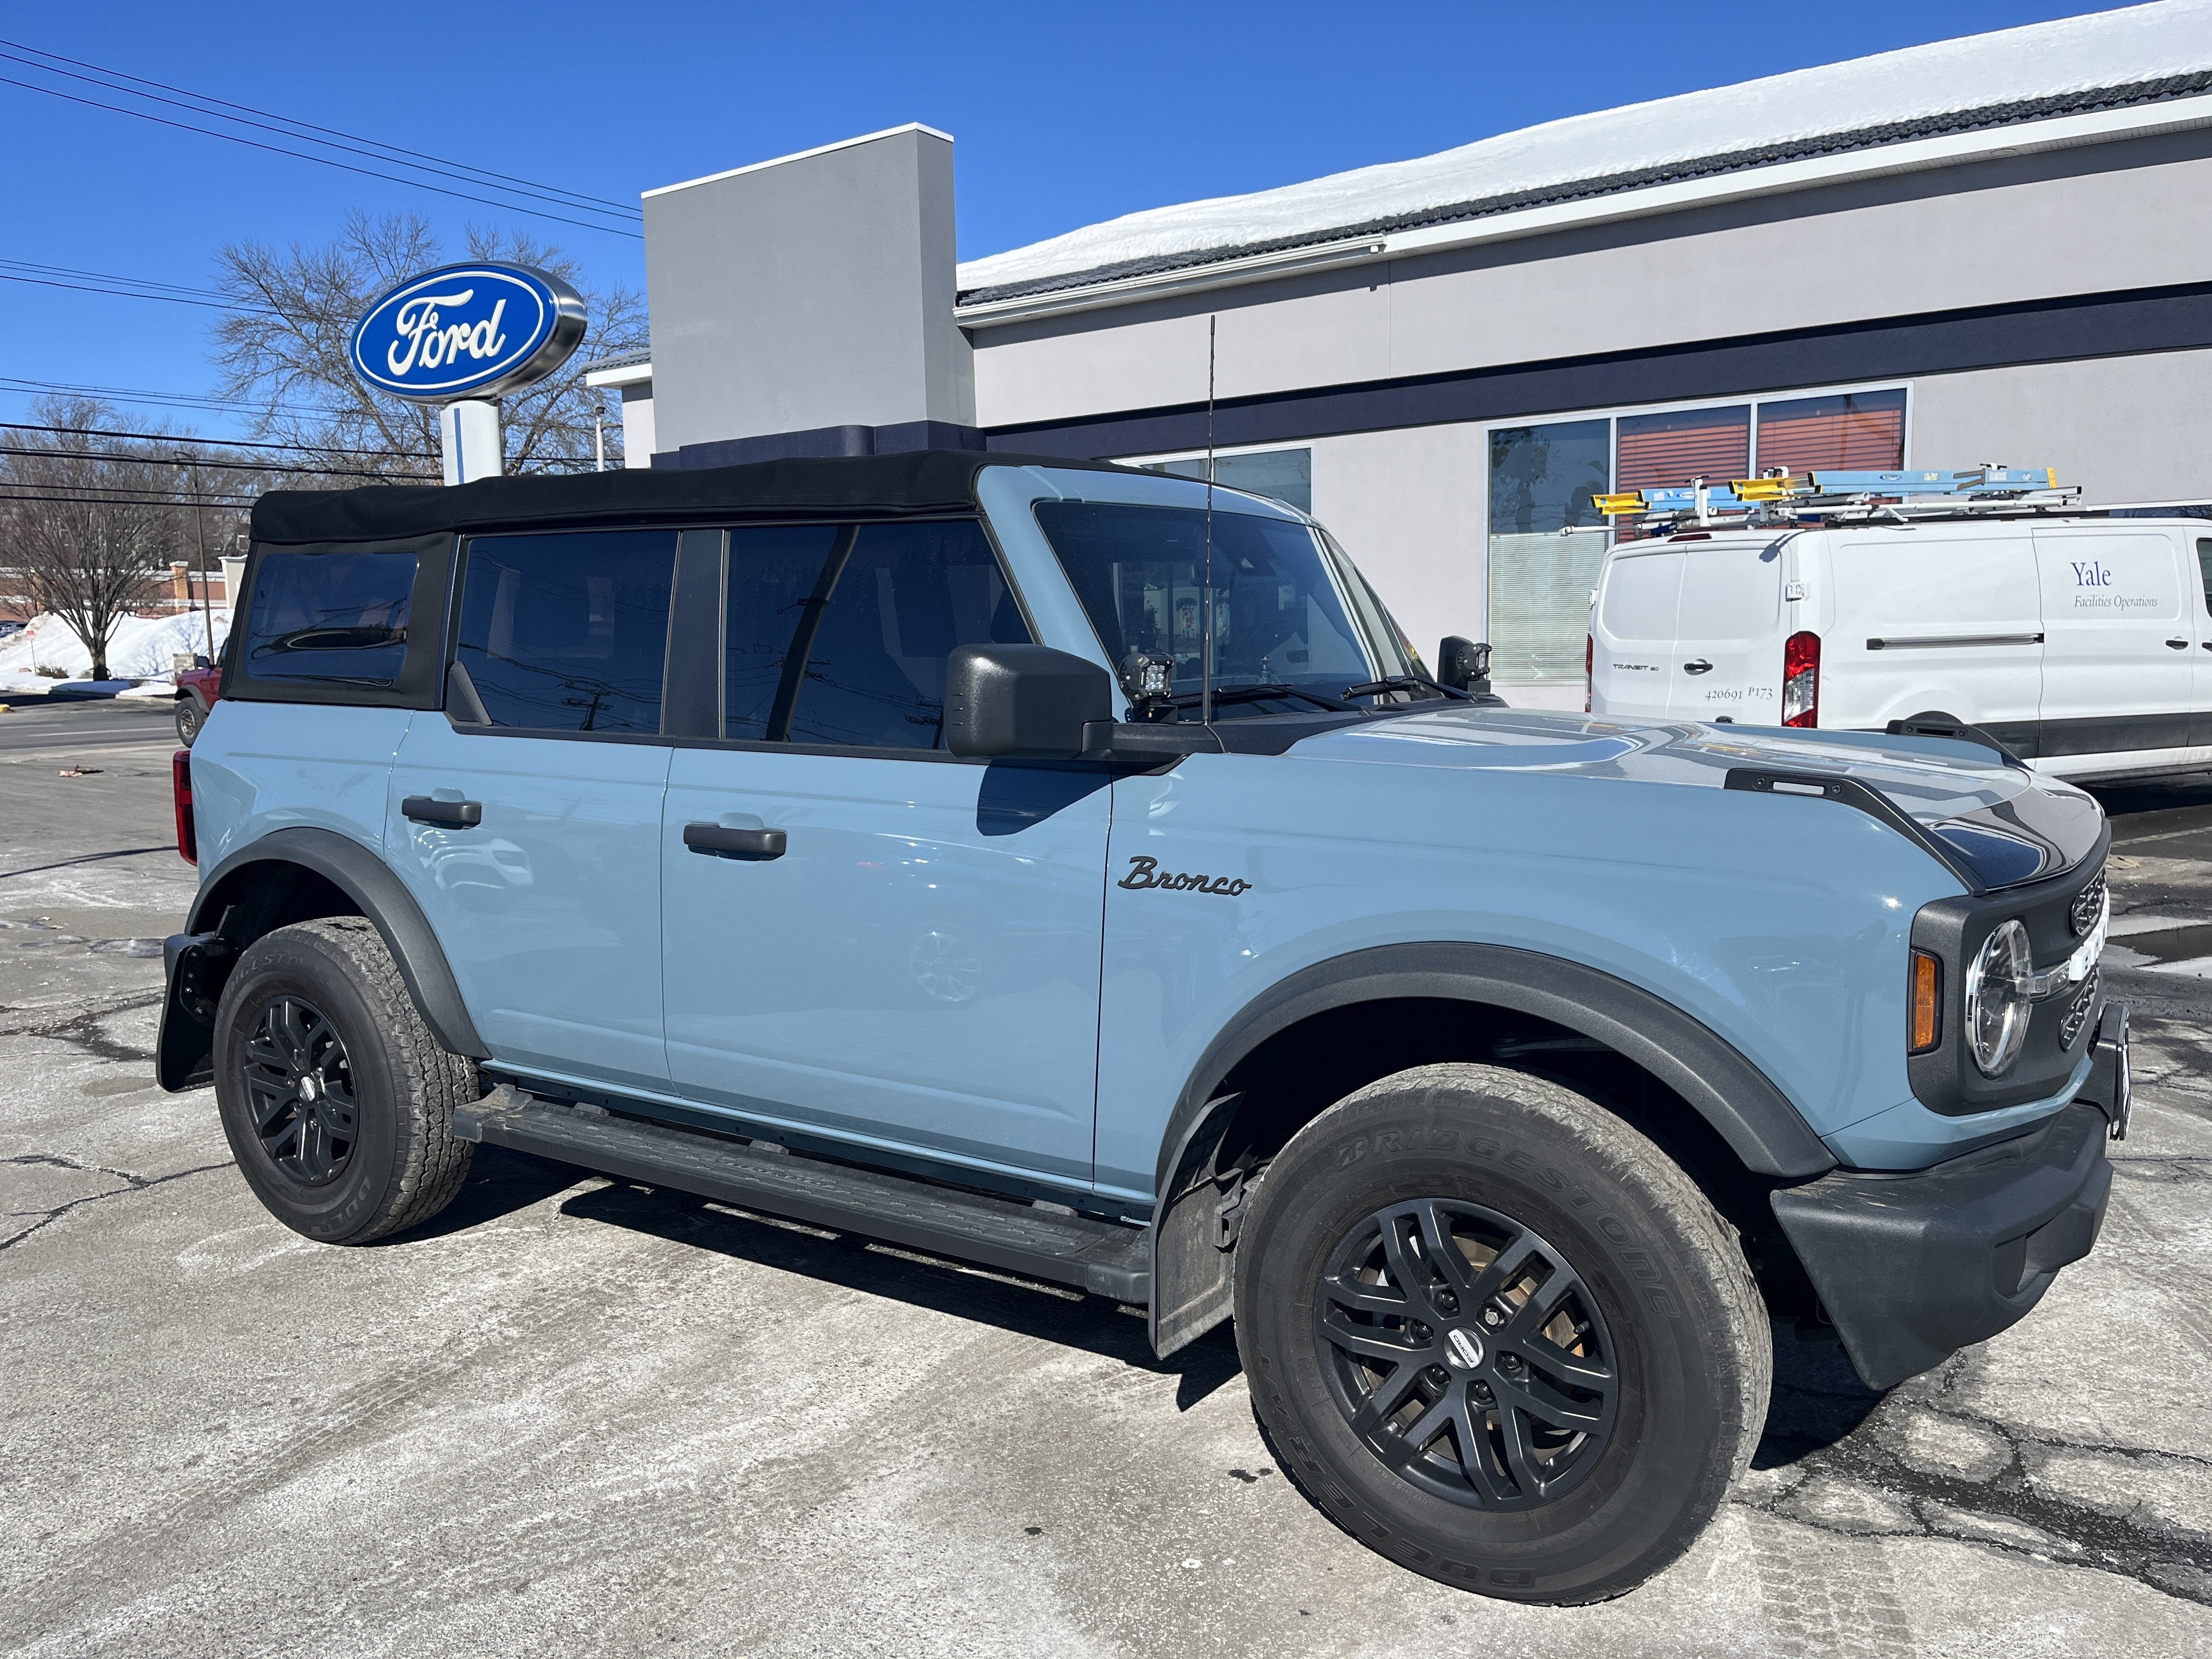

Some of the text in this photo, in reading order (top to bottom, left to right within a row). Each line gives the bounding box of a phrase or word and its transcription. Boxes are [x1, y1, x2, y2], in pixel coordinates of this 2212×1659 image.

[387, 289, 506, 376] Ford
[2070, 561, 2112, 586] Yale
[2074, 594, 2158, 611] Facilities Operations
[1705, 687, 1773, 701] 420691 P173
[1118, 856, 1252, 896] Bronco
[1334, 1128, 1680, 1318] BRIDGESTONE
[1453, 1335, 1474, 1363] FORD
[1287, 1434, 1537, 1590] DUELER
